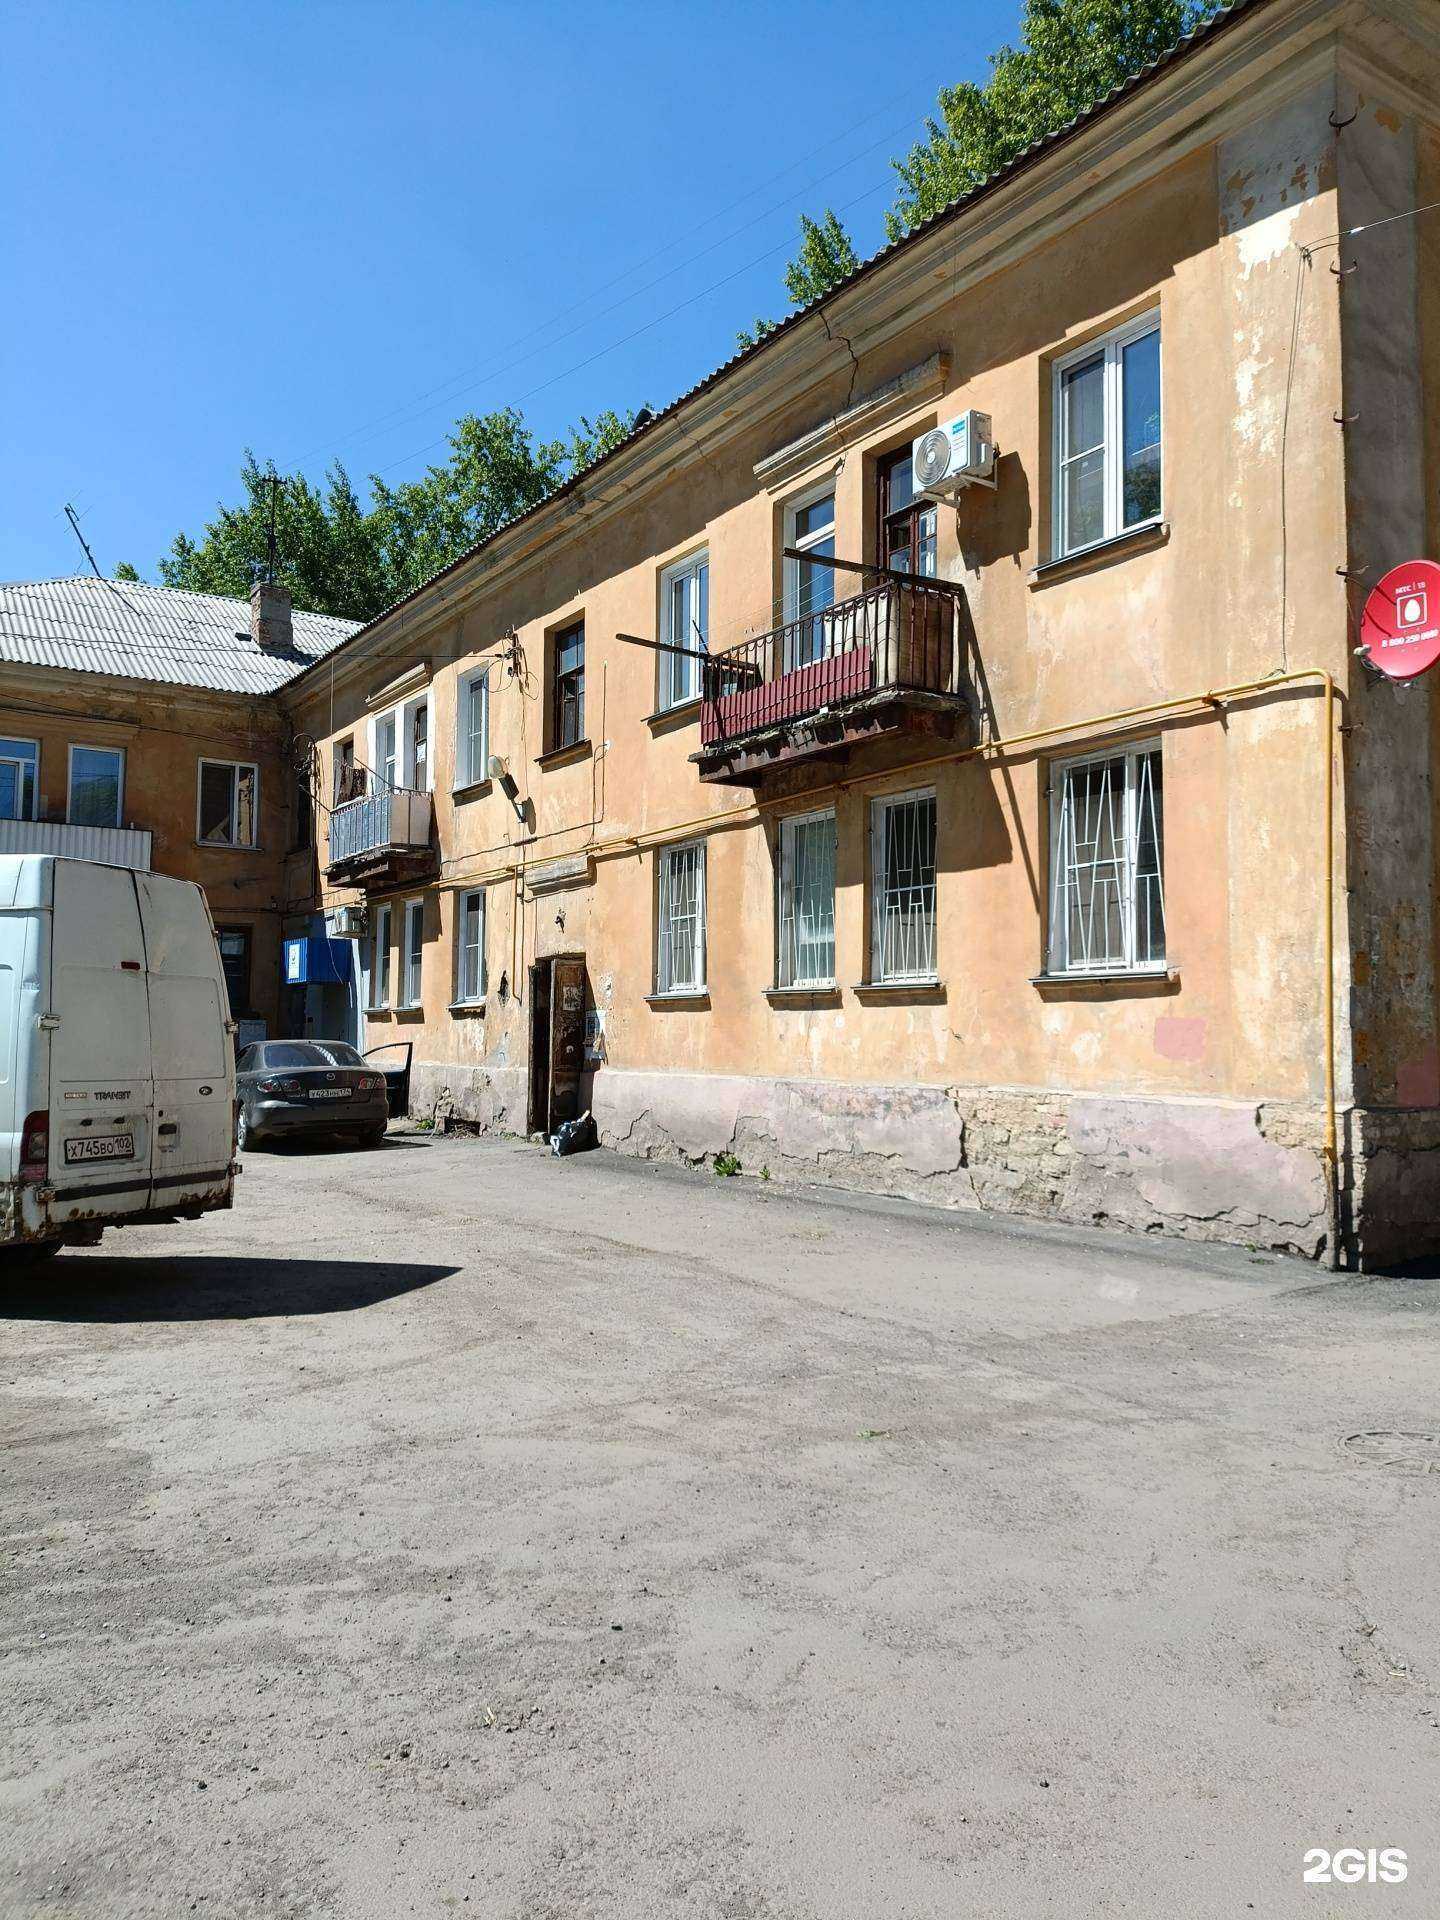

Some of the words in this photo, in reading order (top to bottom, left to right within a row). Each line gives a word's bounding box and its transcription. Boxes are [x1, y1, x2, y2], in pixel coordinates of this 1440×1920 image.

[1381, 639, 1388, 649] 8
[94, 1091, 131, 1100] TRANSIT
[115, 1138, 131, 1149] 102
